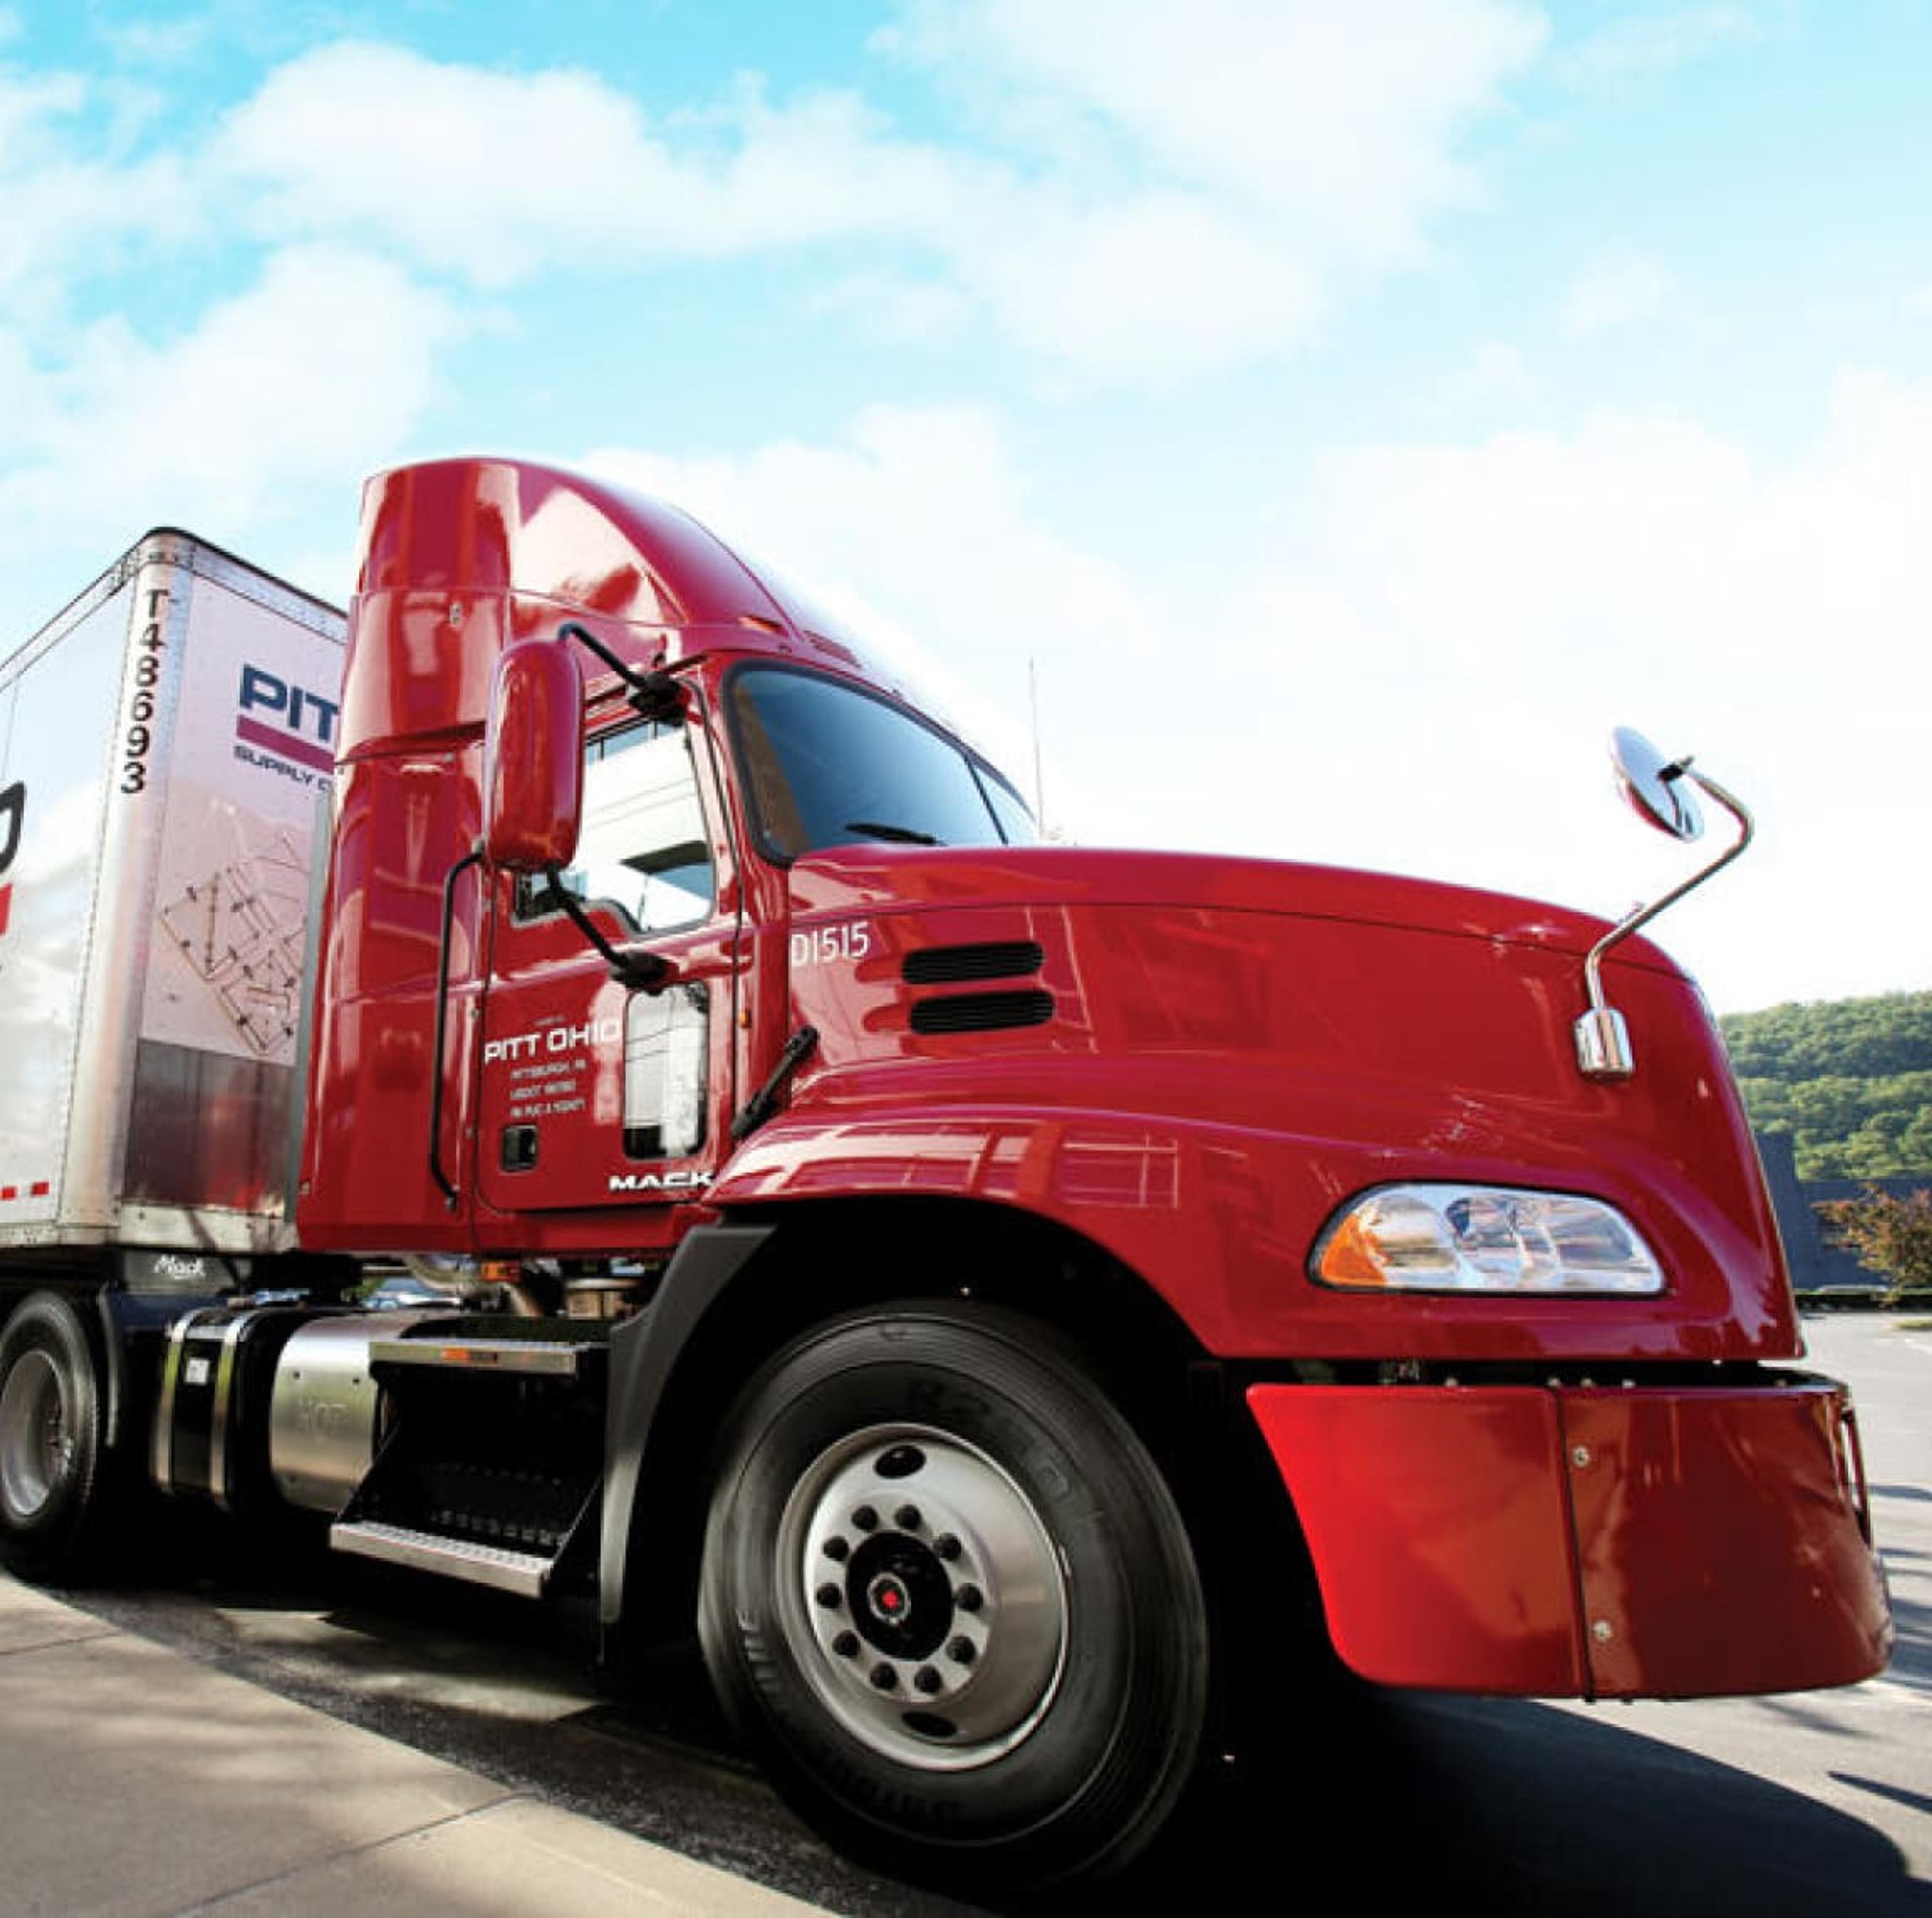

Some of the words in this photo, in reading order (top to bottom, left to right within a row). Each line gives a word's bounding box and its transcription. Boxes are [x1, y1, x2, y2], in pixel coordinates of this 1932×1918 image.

[121, 589, 168, 793] T48693
[234, 745, 314, 785] SUPPLY
[791, 921, 869, 967] D1515
[485, 1032, 542, 1065] PITT
[547, 1018, 621, 1052] OHIO
[609, 1169, 716, 1192] MACK
